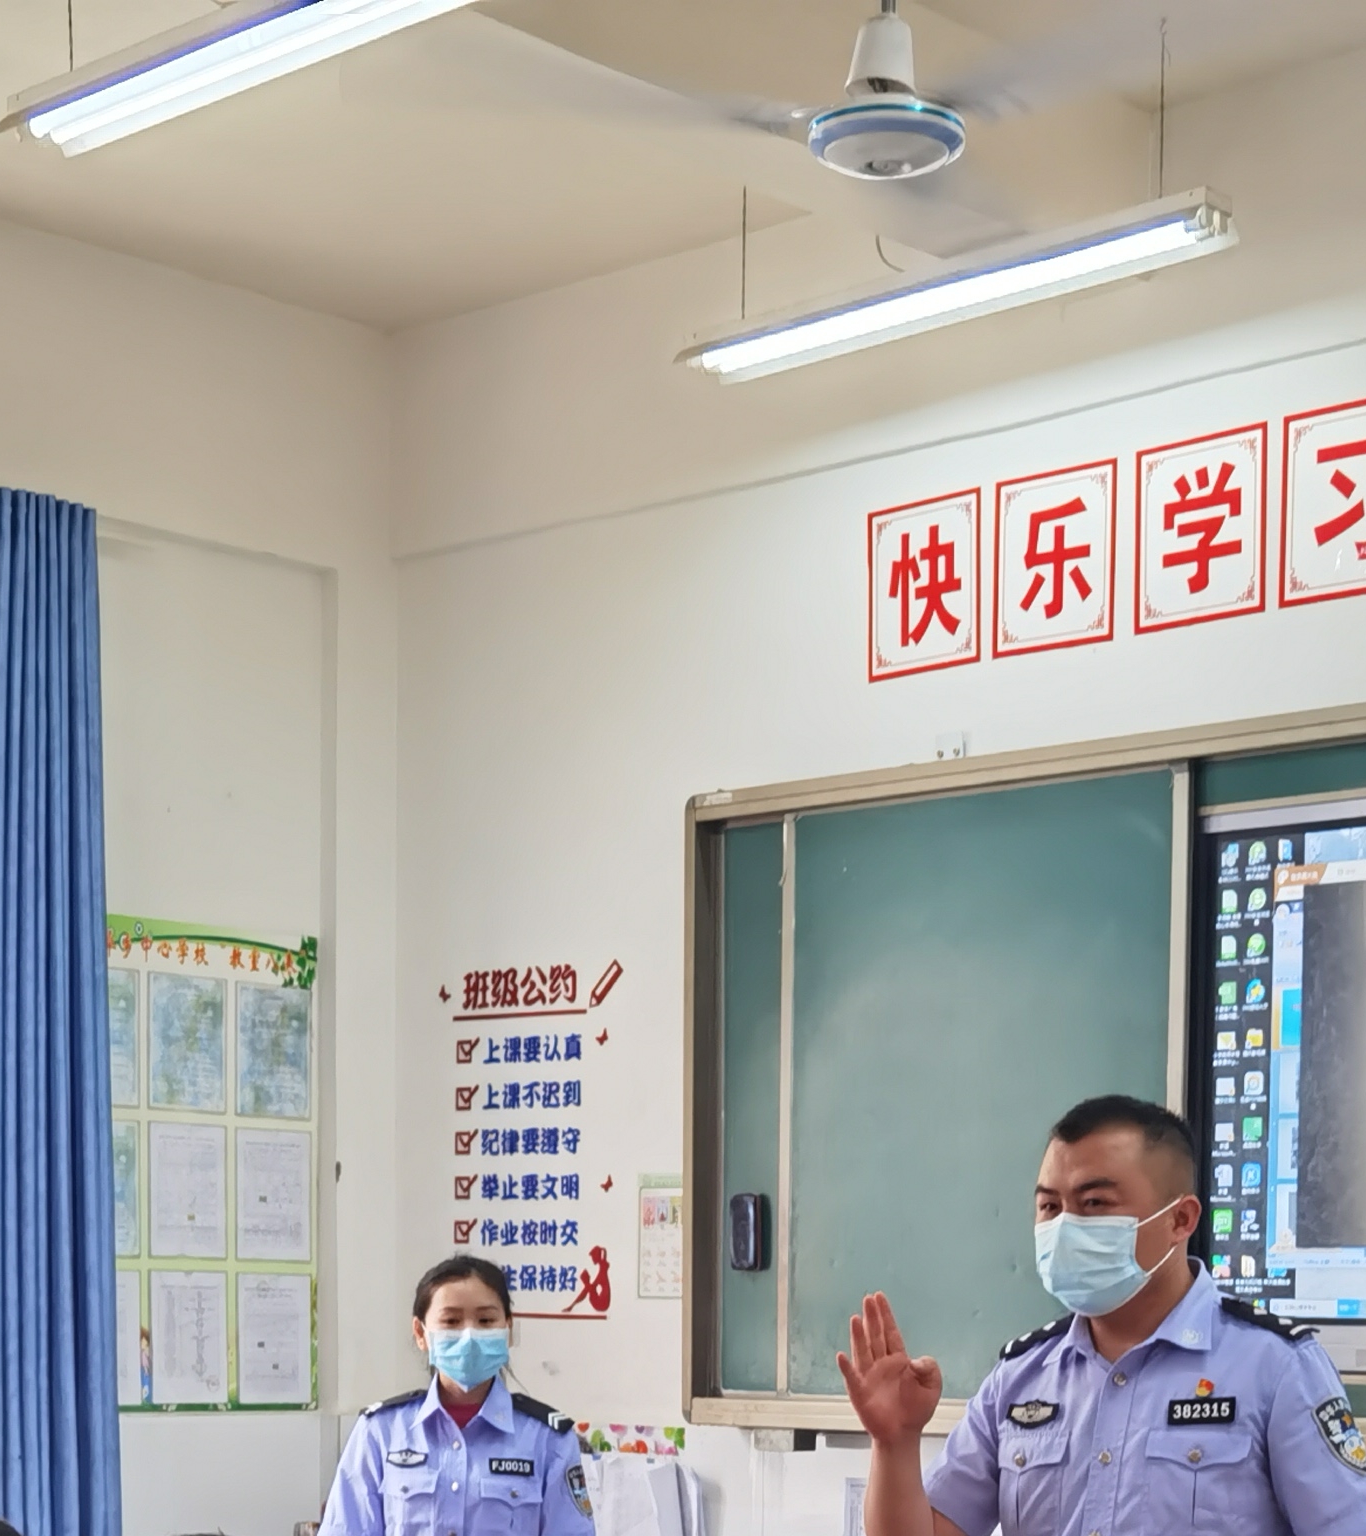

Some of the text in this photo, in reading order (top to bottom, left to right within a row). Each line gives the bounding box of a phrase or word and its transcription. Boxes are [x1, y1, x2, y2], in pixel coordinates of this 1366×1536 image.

[462, 963, 577, 1011] 班级公约
[482, 1032, 582, 1064] 上课要认真
[481, 1079, 582, 1111] 上课不迟到
[481, 1126, 581, 1156] 纪律要遵守
[480, 1173, 580, 1201] 举止要文明
[480, 1217, 579, 1247] 作业按时交
[501, 1263, 578, 1293] 生保持好
[1172, 1402, 1231, 1419] 382315
